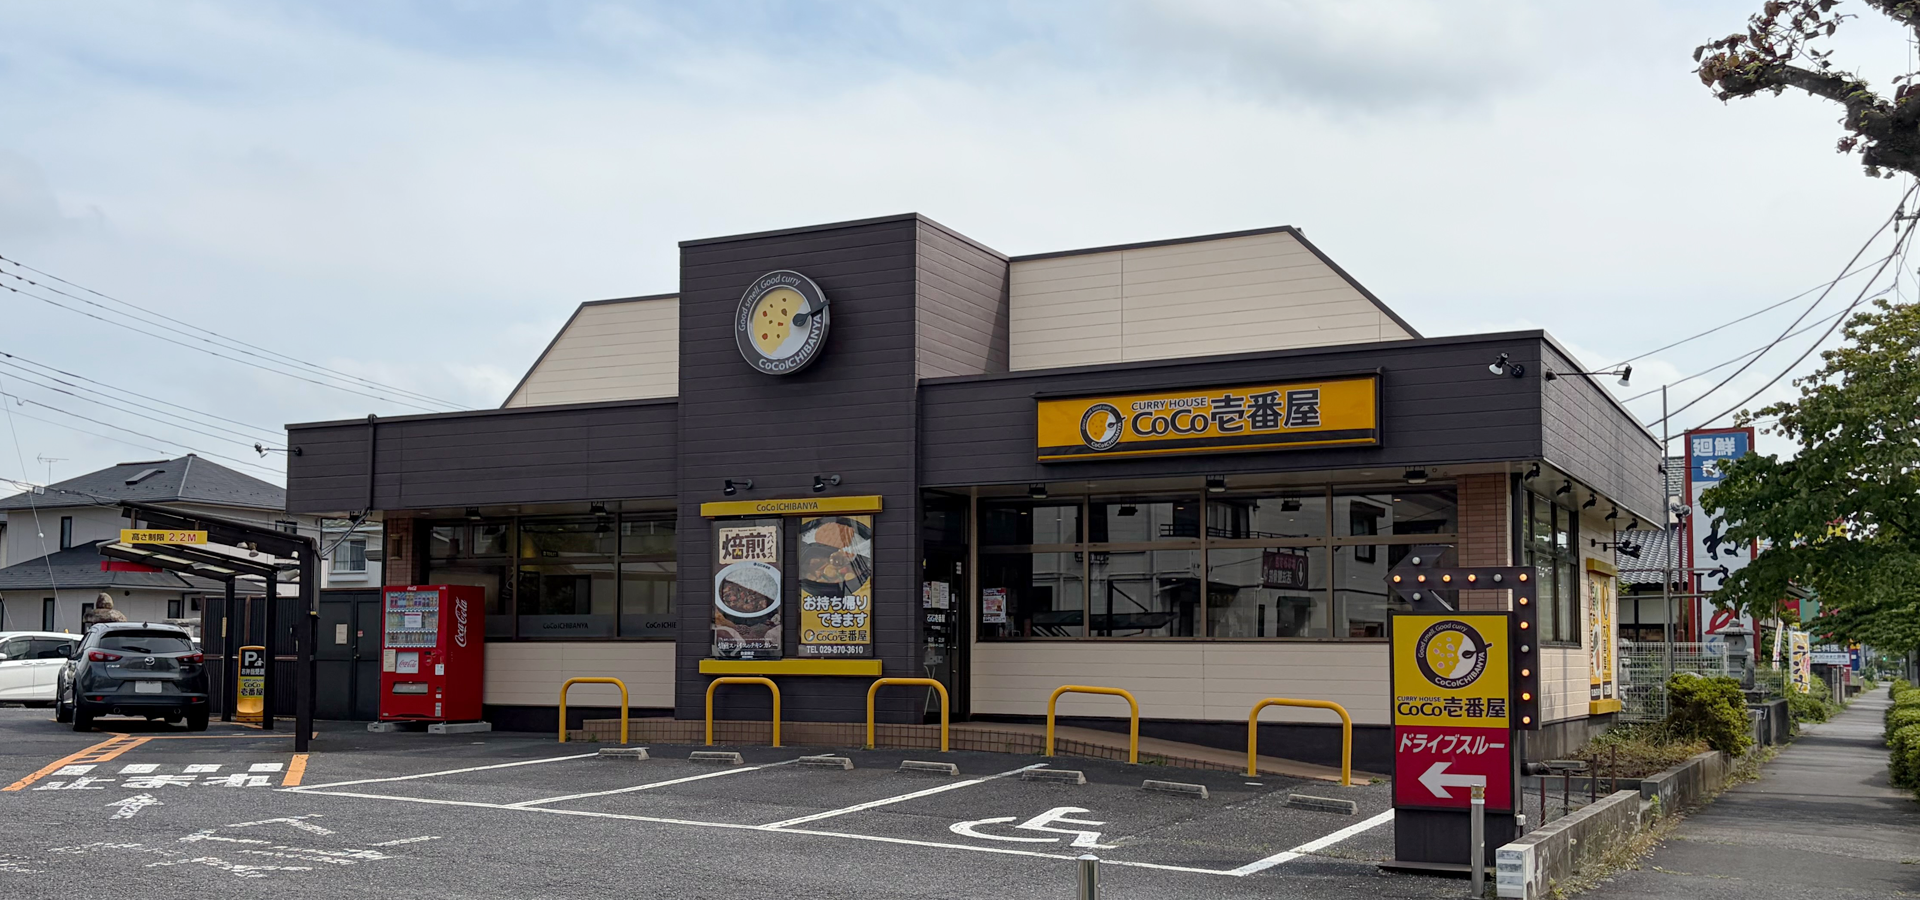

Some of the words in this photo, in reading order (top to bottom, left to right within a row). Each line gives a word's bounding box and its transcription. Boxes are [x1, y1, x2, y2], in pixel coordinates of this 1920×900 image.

[738, 307, 748, 332] Good
[760, 274, 780, 289] Good
[781, 275, 801, 287] curry
[758, 313, 822, 371] CoCoICHIBANYA
[1131, 400, 1166, 411] CURRY
[1168, 397, 1207, 408] HOUSE
[1131, 388, 1321, 437] CoCo壱番屋
[1693, 437, 1736, 457] 廻鮮
[131, 532, 165, 542] 高さ制限
[168, 532, 197, 542] 2.2M
[722, 532, 766, 560] 焙煎
[803, 595, 868, 611] お持ち帰り
[455, 597, 467, 648] Coca-Cola
[818, 612, 868, 628] できます
[806, 646, 819, 654] TEL
[819, 645, 864, 654] 029-870-3610
[1417, 641, 1426, 659] Good
[1435, 622, 1452, 633] Good
[1452, 623, 1468, 633] curry
[244, 651, 258, 667] P
[1434, 651, 1486, 688] CoCoICHIBANYA
[240, 688, 264, 696] 壱番屋
[1397, 697, 1507, 718] CoCo壱番屋
[1399, 733, 1505, 755] ドライブスルー
[32, 773, 273, 792] 止まれ
